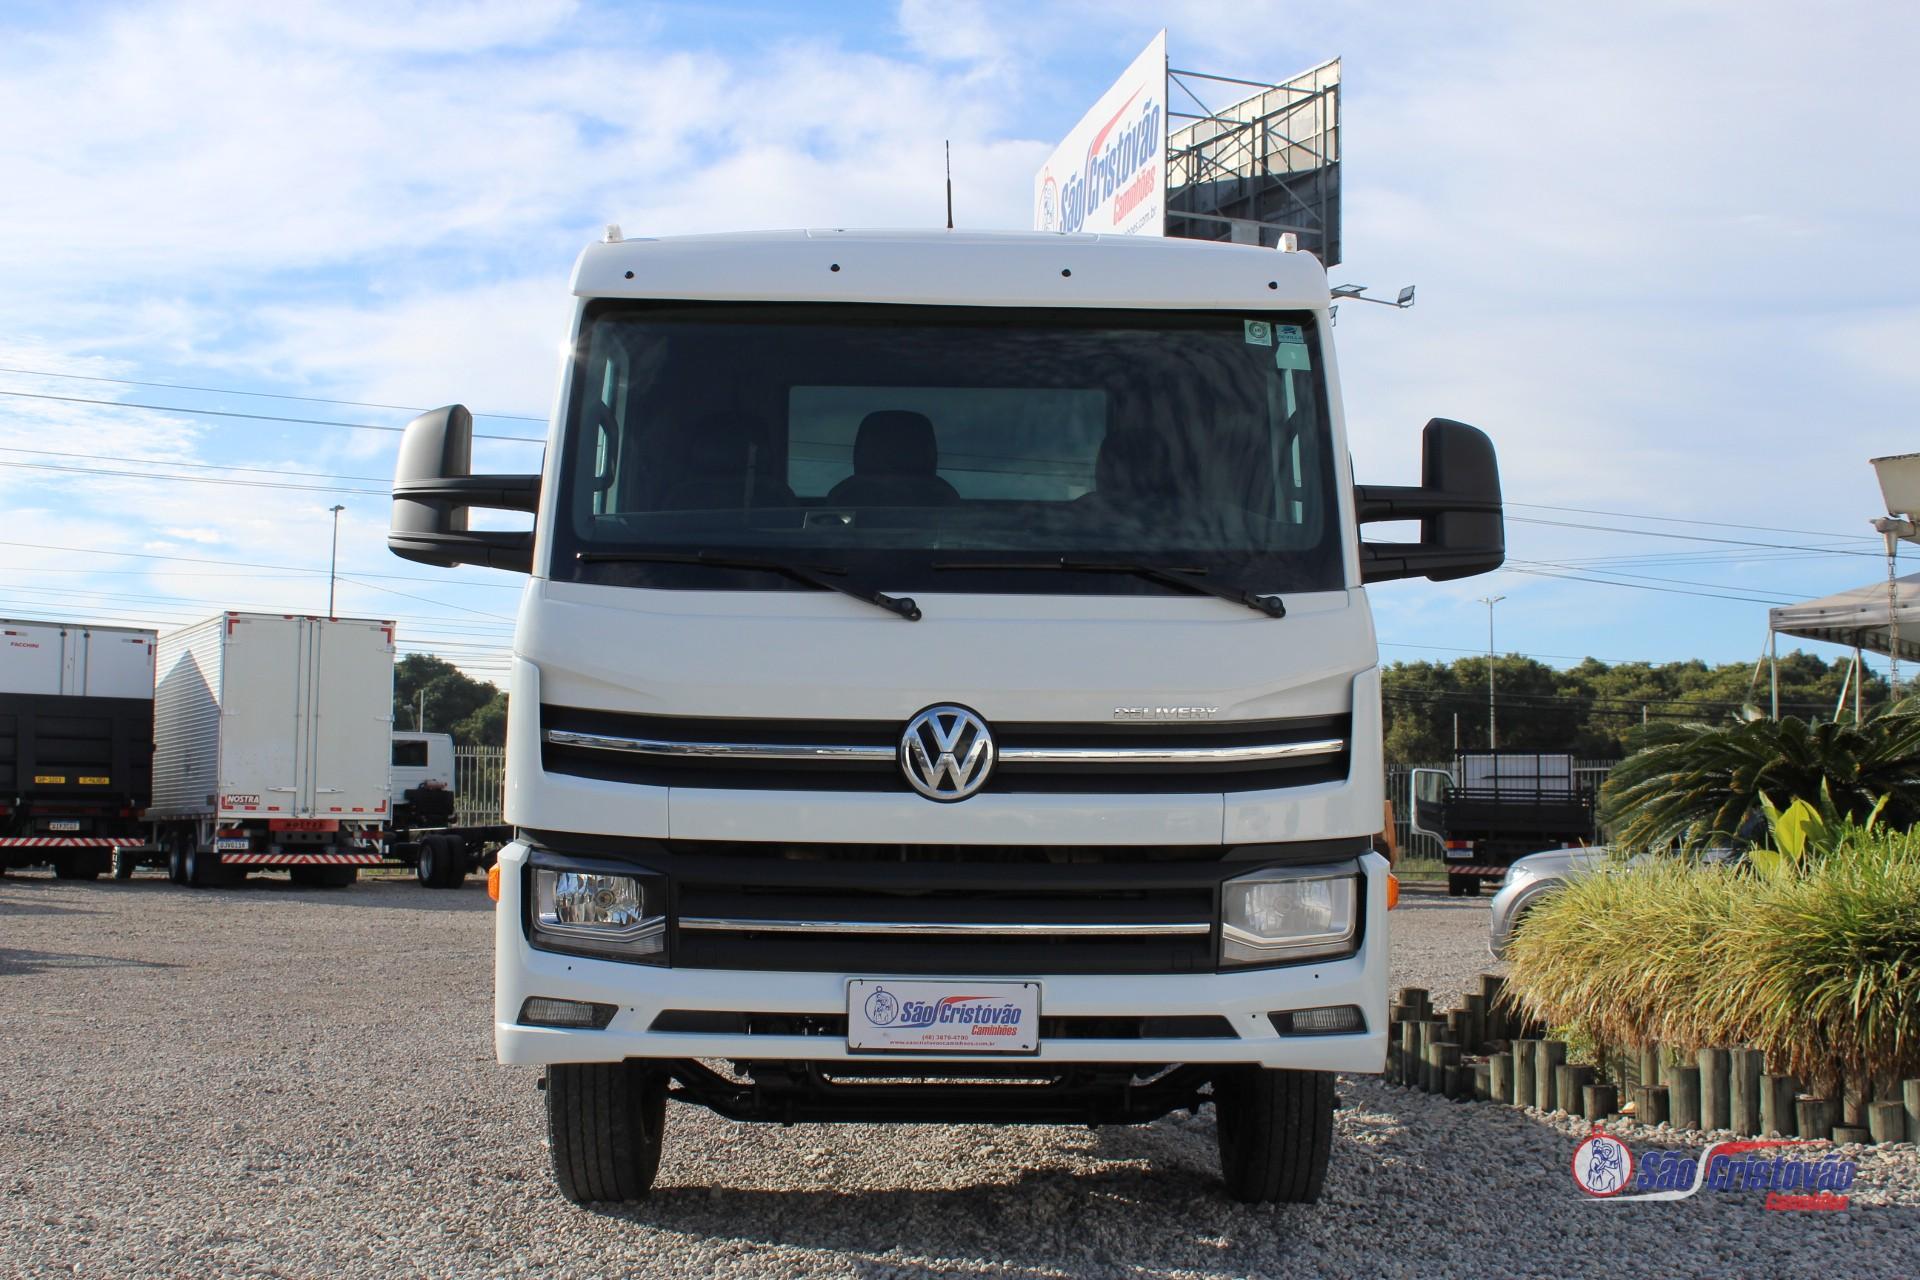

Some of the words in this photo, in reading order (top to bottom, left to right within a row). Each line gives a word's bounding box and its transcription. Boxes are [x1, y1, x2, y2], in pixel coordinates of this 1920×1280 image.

[1059, 171, 1086, 233] São
[1087, 97, 1160, 216] Cristóvão
[1114, 706, 1219, 719] DELIVERY
[227, 795, 260, 804] NOSTRA
[901, 1001, 934, 1023] São
[939, 1002, 1021, 1025] Cristóvão
[971, 1025, 1018, 1036] Caminhões
